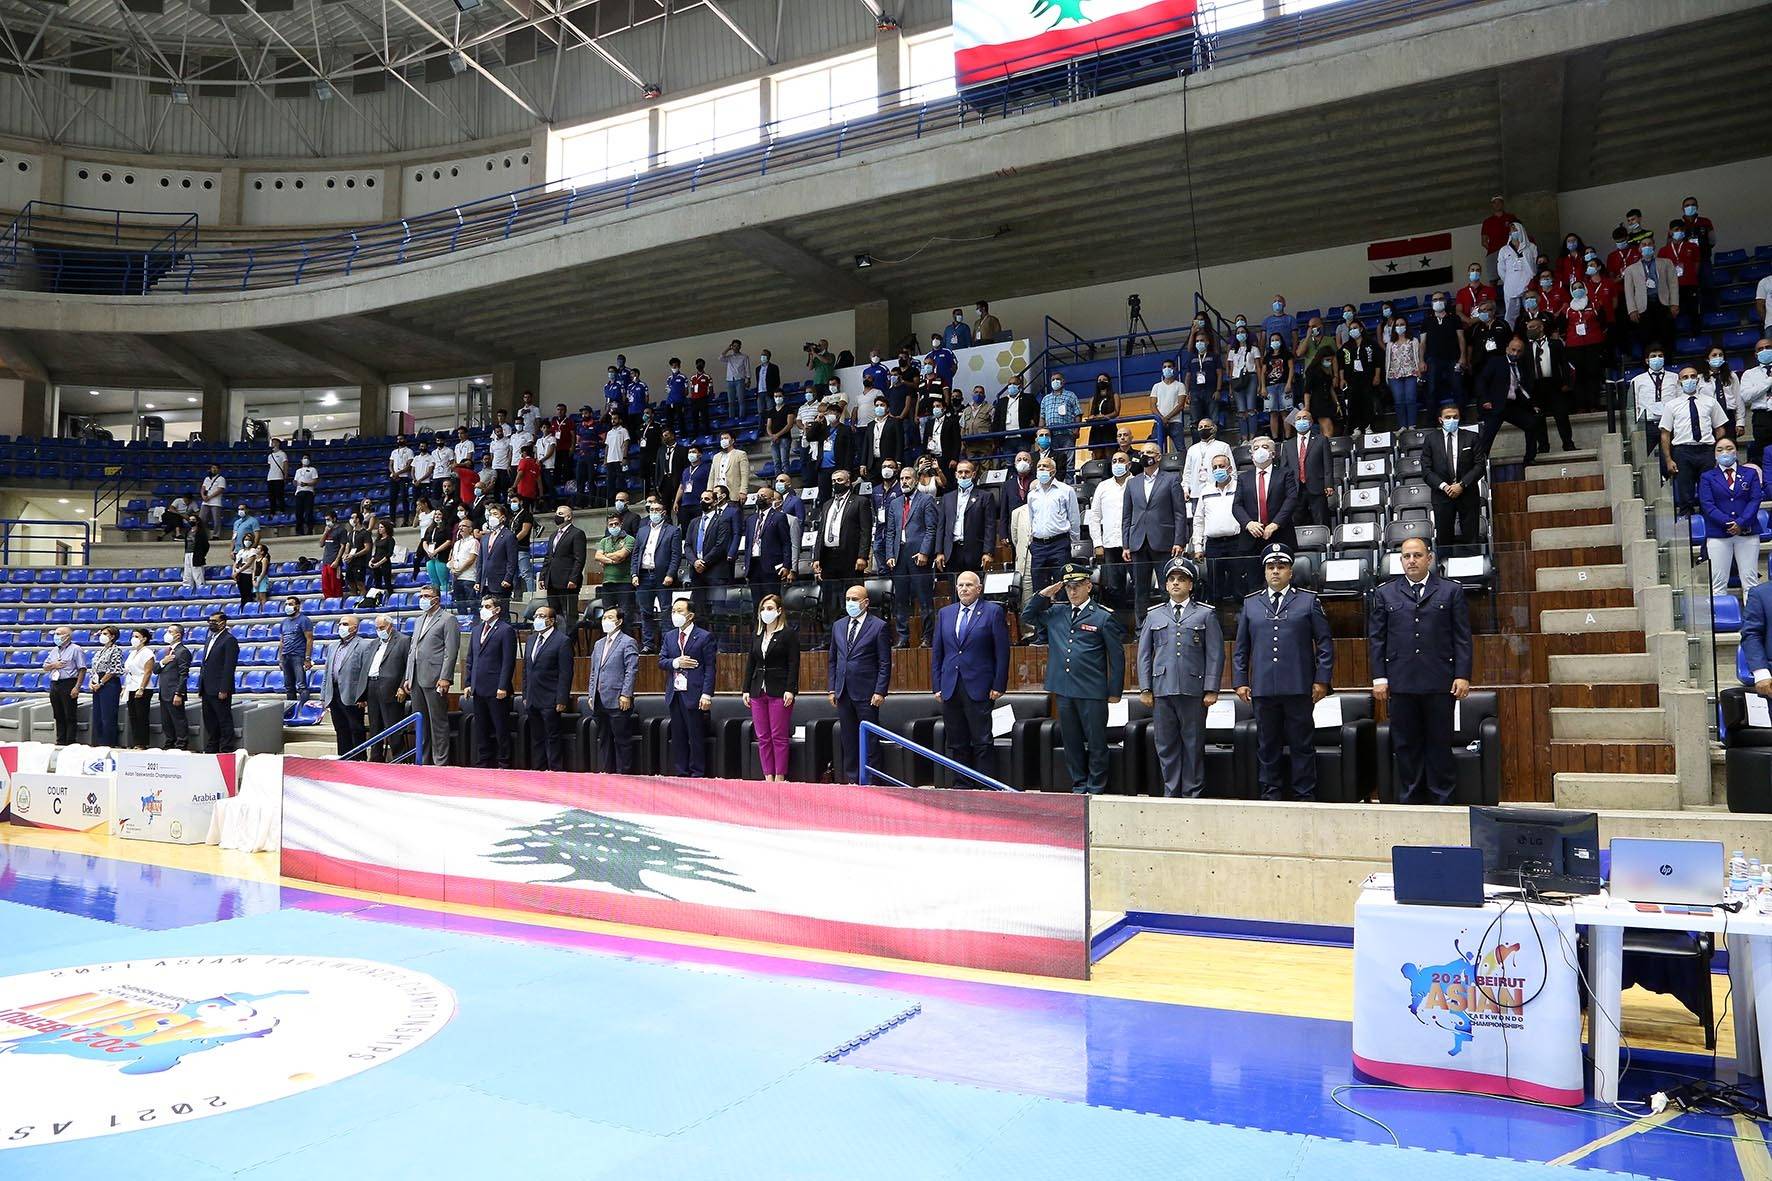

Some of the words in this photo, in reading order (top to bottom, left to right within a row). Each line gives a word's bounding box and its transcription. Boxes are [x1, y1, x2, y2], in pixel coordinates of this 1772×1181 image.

[1561, 468, 1567, 476] F
[1578, 572, 1587, 580] B
[1585, 614, 1596, 624] A
[147, 762, 159, 770] 2021
[47, 786, 68, 796] COURT
[191, 793, 217, 802] Arabia
[53, 797, 62, 815] C
[1530, 837, 1543, 846] LG
[1660, 864, 1673, 876] hp
[1432, 973, 1470, 985] 2021
[1476, 976, 1526, 988] BEIRUT
[1424, 982, 1524, 1016] ASIAN
[1469, 1012, 1524, 1022] TAEKWONDO
[1469, 1020, 1525, 1030] CHAMPIONSHIPS
[60, 1026, 142, 1053] 2021
[109, 1095, 228, 1127] 2021
